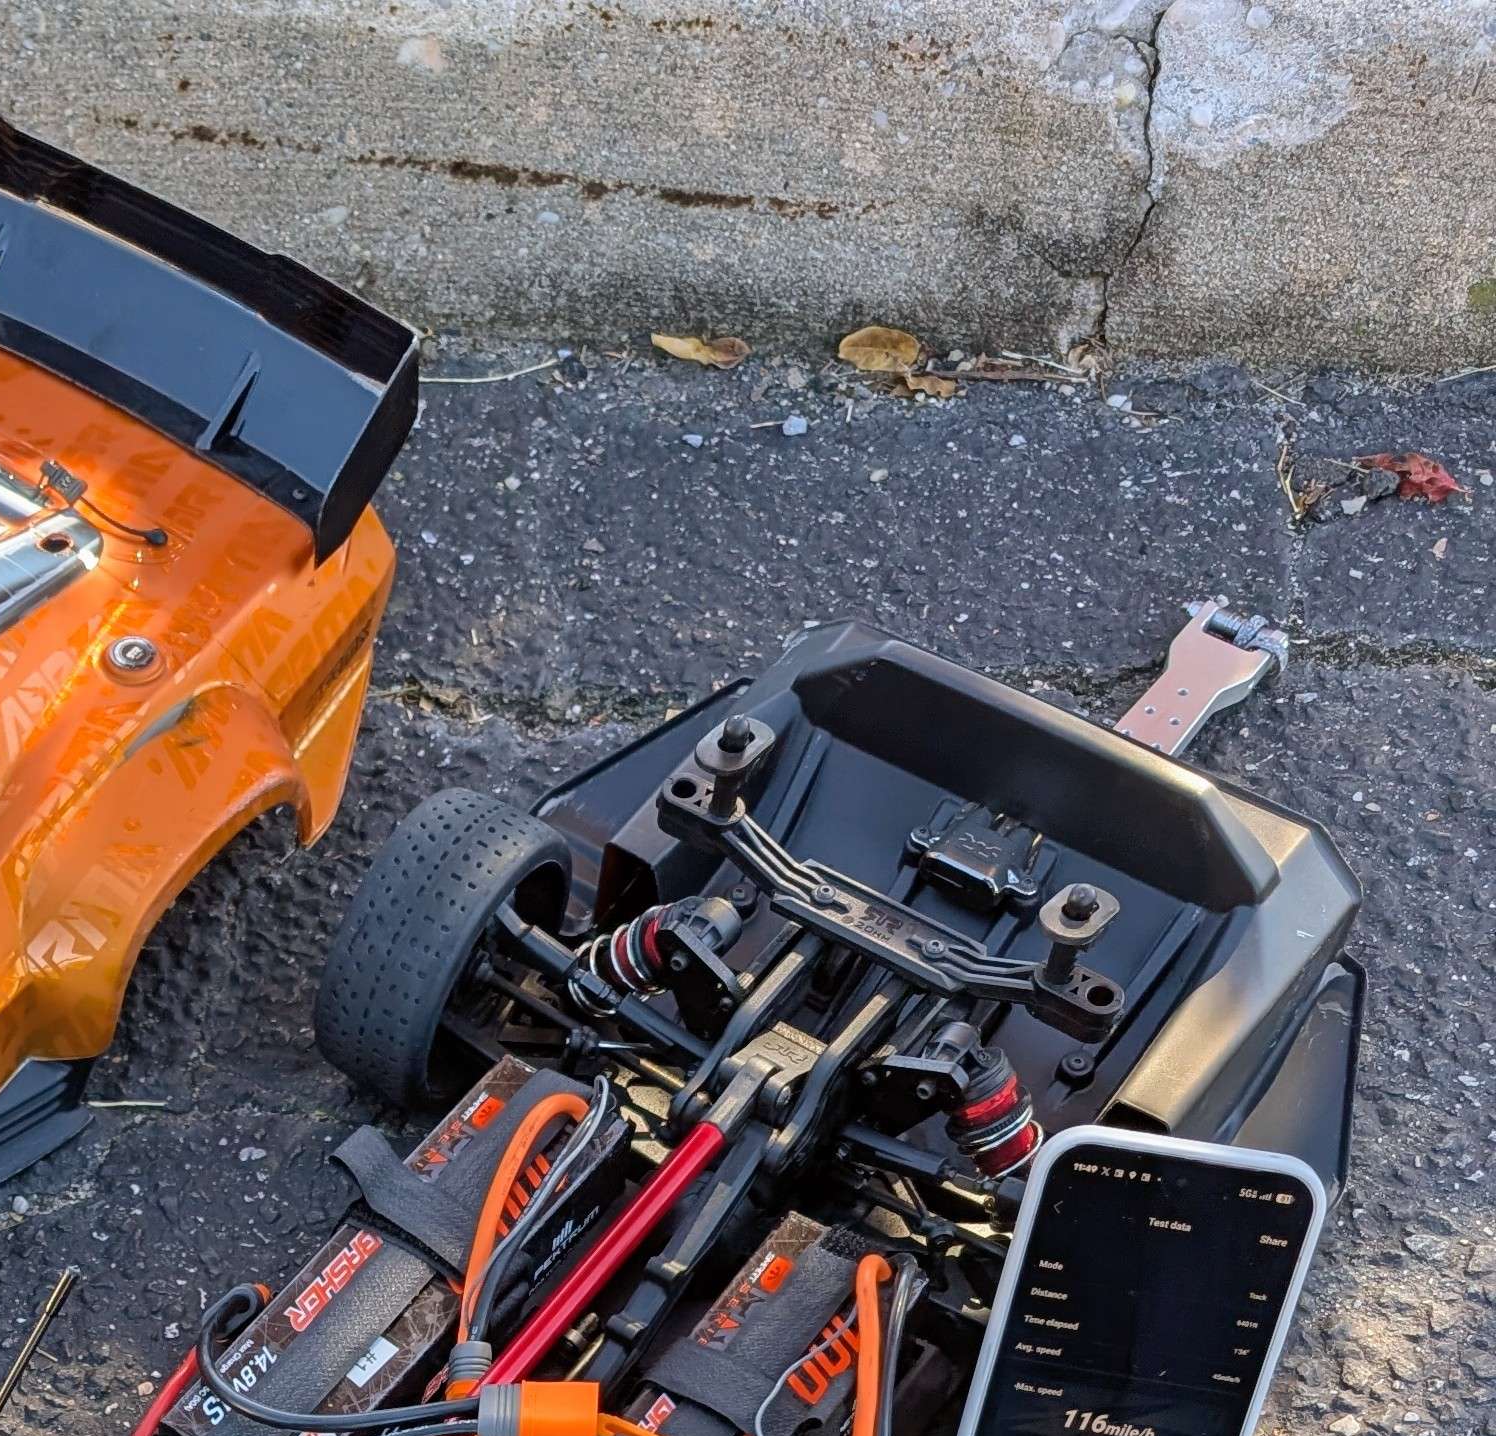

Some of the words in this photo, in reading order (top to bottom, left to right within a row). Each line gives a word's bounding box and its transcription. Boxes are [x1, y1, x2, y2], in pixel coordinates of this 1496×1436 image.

[1149, 1217, 1169, 1230] Test
[1170, 1221, 1191, 1232] data
[1259, 1235, 1288, 1248] Share
[1039, 1260, 1063, 1271] Mode
[1030, 1287, 1068, 1300] Distance
[1024, 1315, 1045, 1325] Time
[1046, 1319, 1080, 1331] elapsed
[1015, 1342, 1034, 1353] Avg.
[1036, 1347, 1062, 1356] speed
[217, 1349, 242, 1375] Charge
[1014, 1383, 1035, 1393] Max.
[1037, 1388, 1063, 1397] speed
